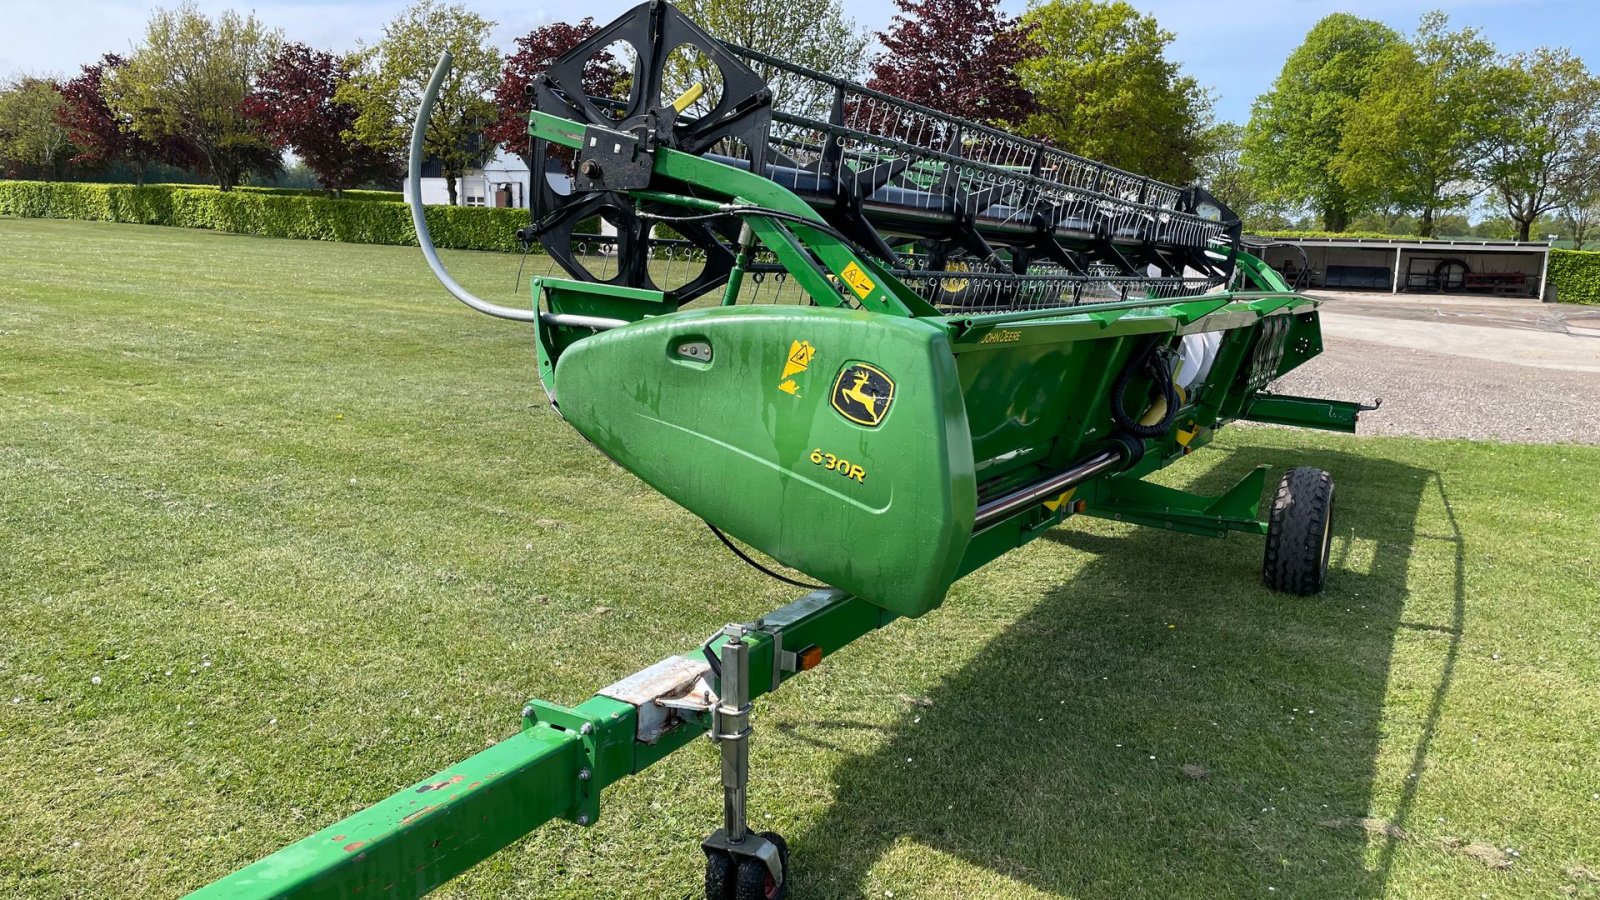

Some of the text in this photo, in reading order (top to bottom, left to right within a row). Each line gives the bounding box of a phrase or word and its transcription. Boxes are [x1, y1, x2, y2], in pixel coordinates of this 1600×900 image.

[981, 330, 1022, 344] JOHN DEERE
[810, 448, 866, 484] 630R
